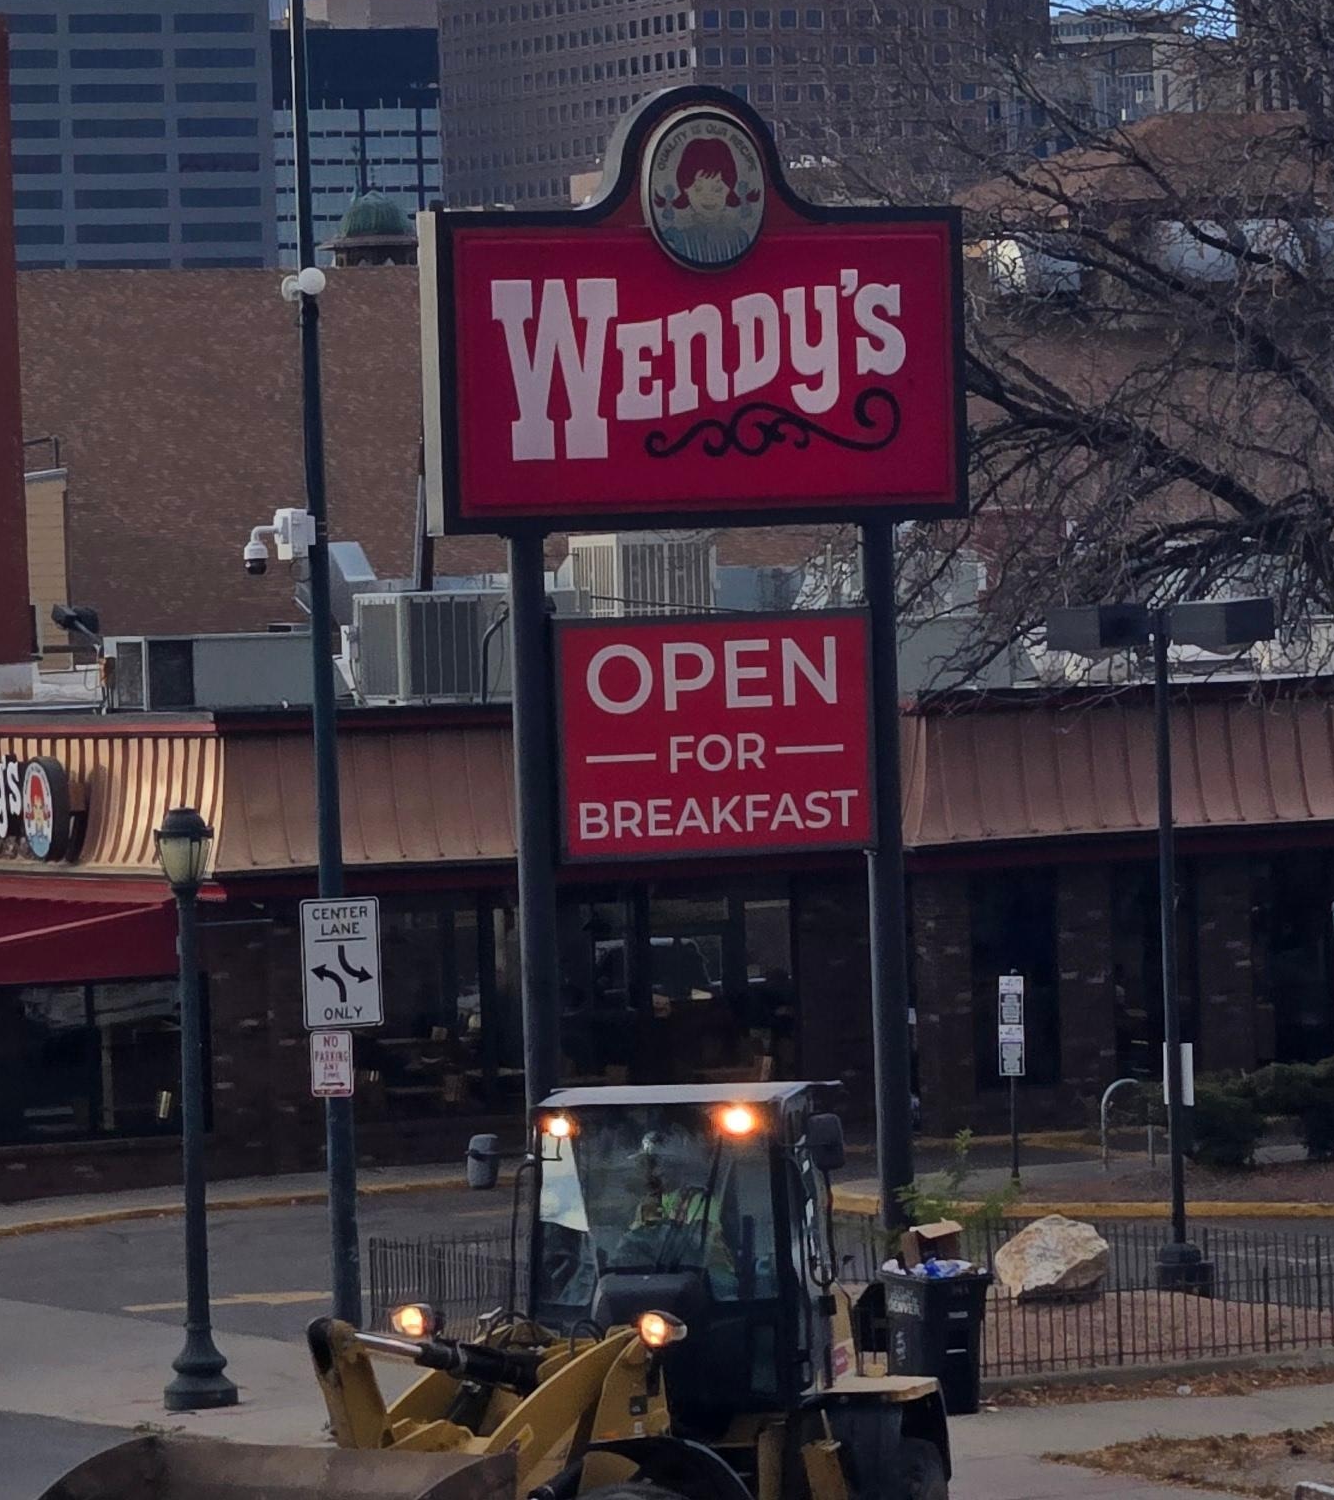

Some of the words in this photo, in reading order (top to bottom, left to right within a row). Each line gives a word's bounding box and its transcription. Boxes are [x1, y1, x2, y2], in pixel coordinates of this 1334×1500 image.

[657, 130, 688, 171] QUALITY
[690, 124, 701, 135] IS
[705, 123, 728, 136] OUR
[729, 133, 757, 172] RECIPE
[586, 636, 838, 714] OPEN
[670, 732, 766, 773] FOR
[579, 789, 858, 840] BREAKFAST
[312, 906, 367, 920] CENTER
[321, 922, 360, 936] LANE
[324, 1006, 363, 1020] ONLY
[323, 1035, 339, 1048] NO
[315, 1050, 349, 1063] PARKING
[323, 1062, 339, 1071] ANY
